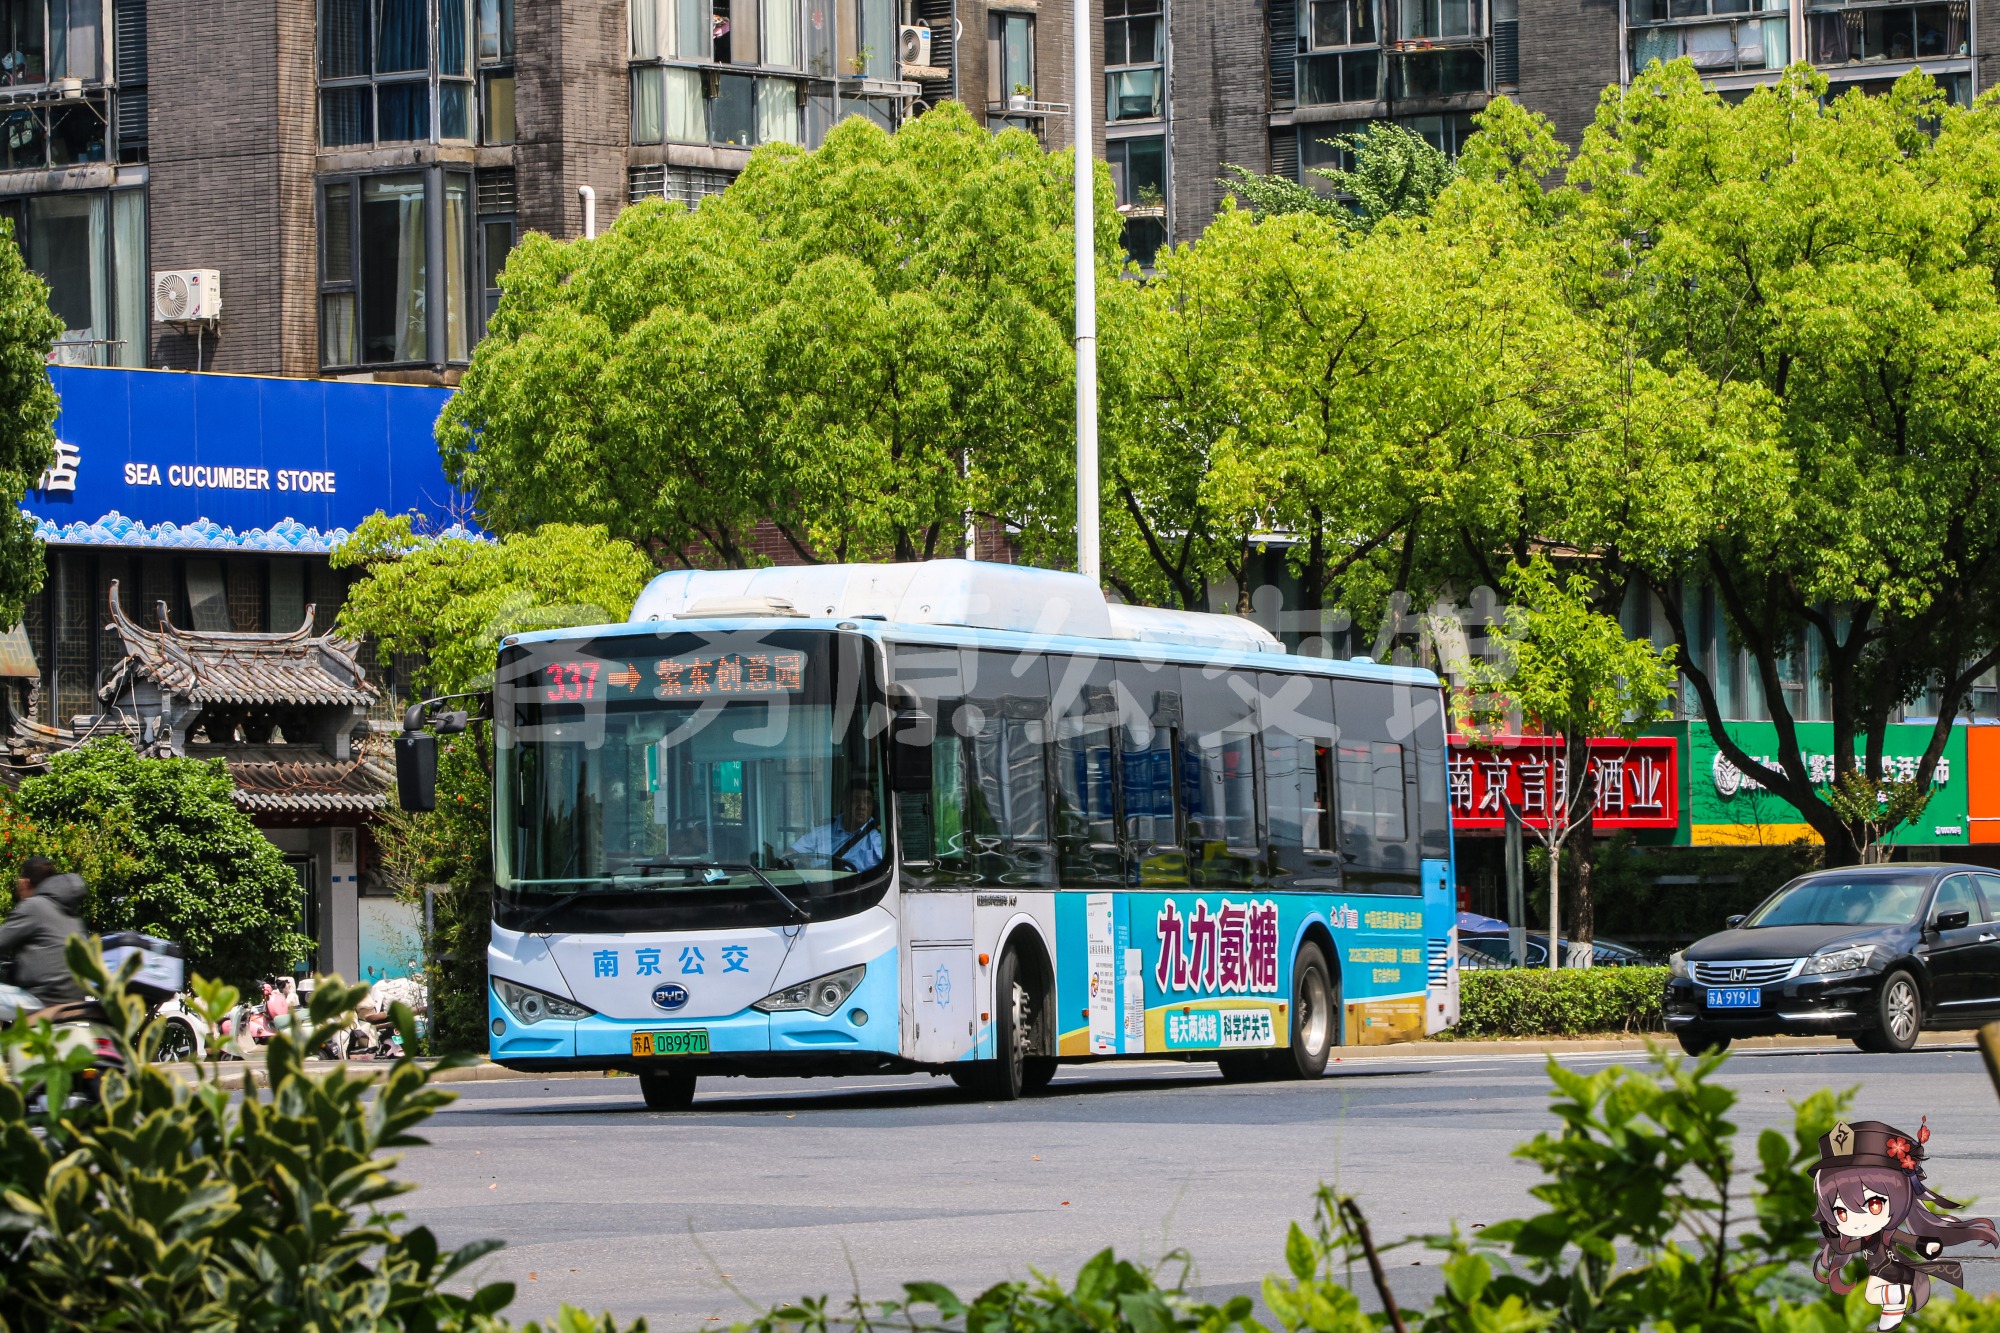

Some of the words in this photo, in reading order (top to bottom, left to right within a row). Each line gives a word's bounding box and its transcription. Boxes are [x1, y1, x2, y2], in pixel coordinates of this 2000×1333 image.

[125, 463, 161, 486] SEA
[168, 465, 270, 490] CUCUMBER
[277, 469, 336, 493] STORE
[546, 661, 600, 701] 337
[656, 652, 802, 696] 紫东创意园
[1448, 753, 1663, 813] 南京言酒业
[592, 944, 750, 978] 南京公交
[1156, 898, 1278, 994] 九力氨糖
[655, 990, 685, 1003] BYD
[1169, 1014, 1218, 1043] 每天两块钱
[1223, 1014, 1271, 1042] 科学护关节
